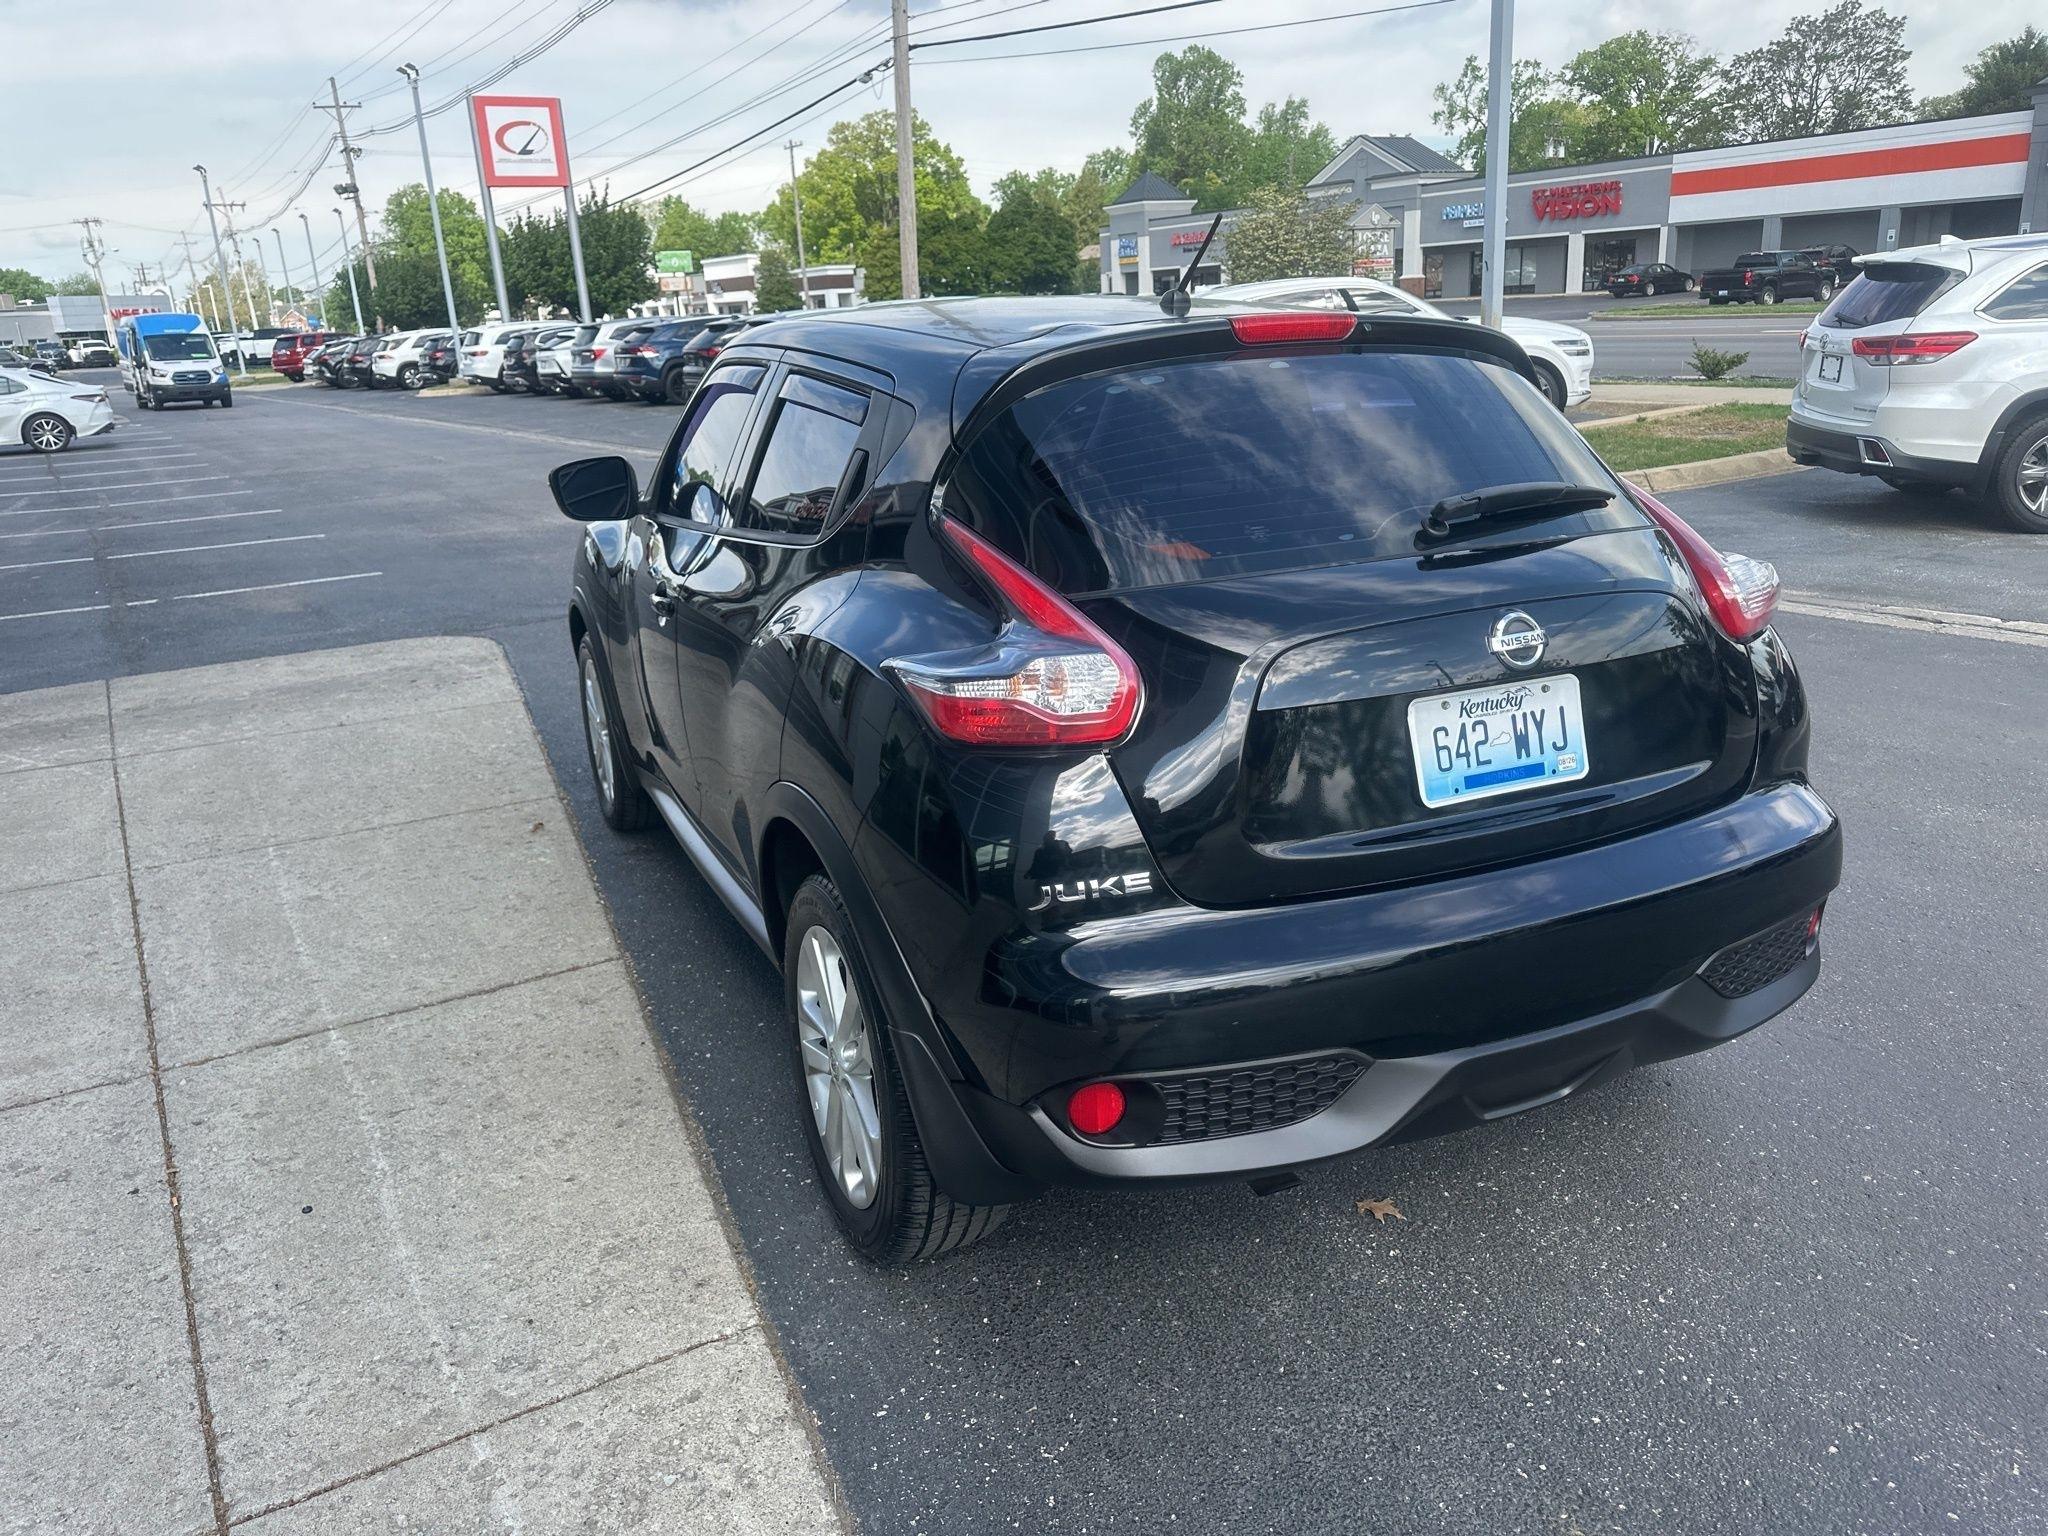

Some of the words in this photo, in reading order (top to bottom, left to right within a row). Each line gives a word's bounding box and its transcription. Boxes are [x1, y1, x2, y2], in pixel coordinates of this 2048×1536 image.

[1532, 194, 1622, 221] VISION
[1500, 631, 1545, 649] NISSAN
[1459, 692, 1524, 719] Kentucky
[1432, 719, 1492, 773] 642
[1510, 705, 1568, 760] WYJ
[1028, 871, 1153, 911] JUKE
